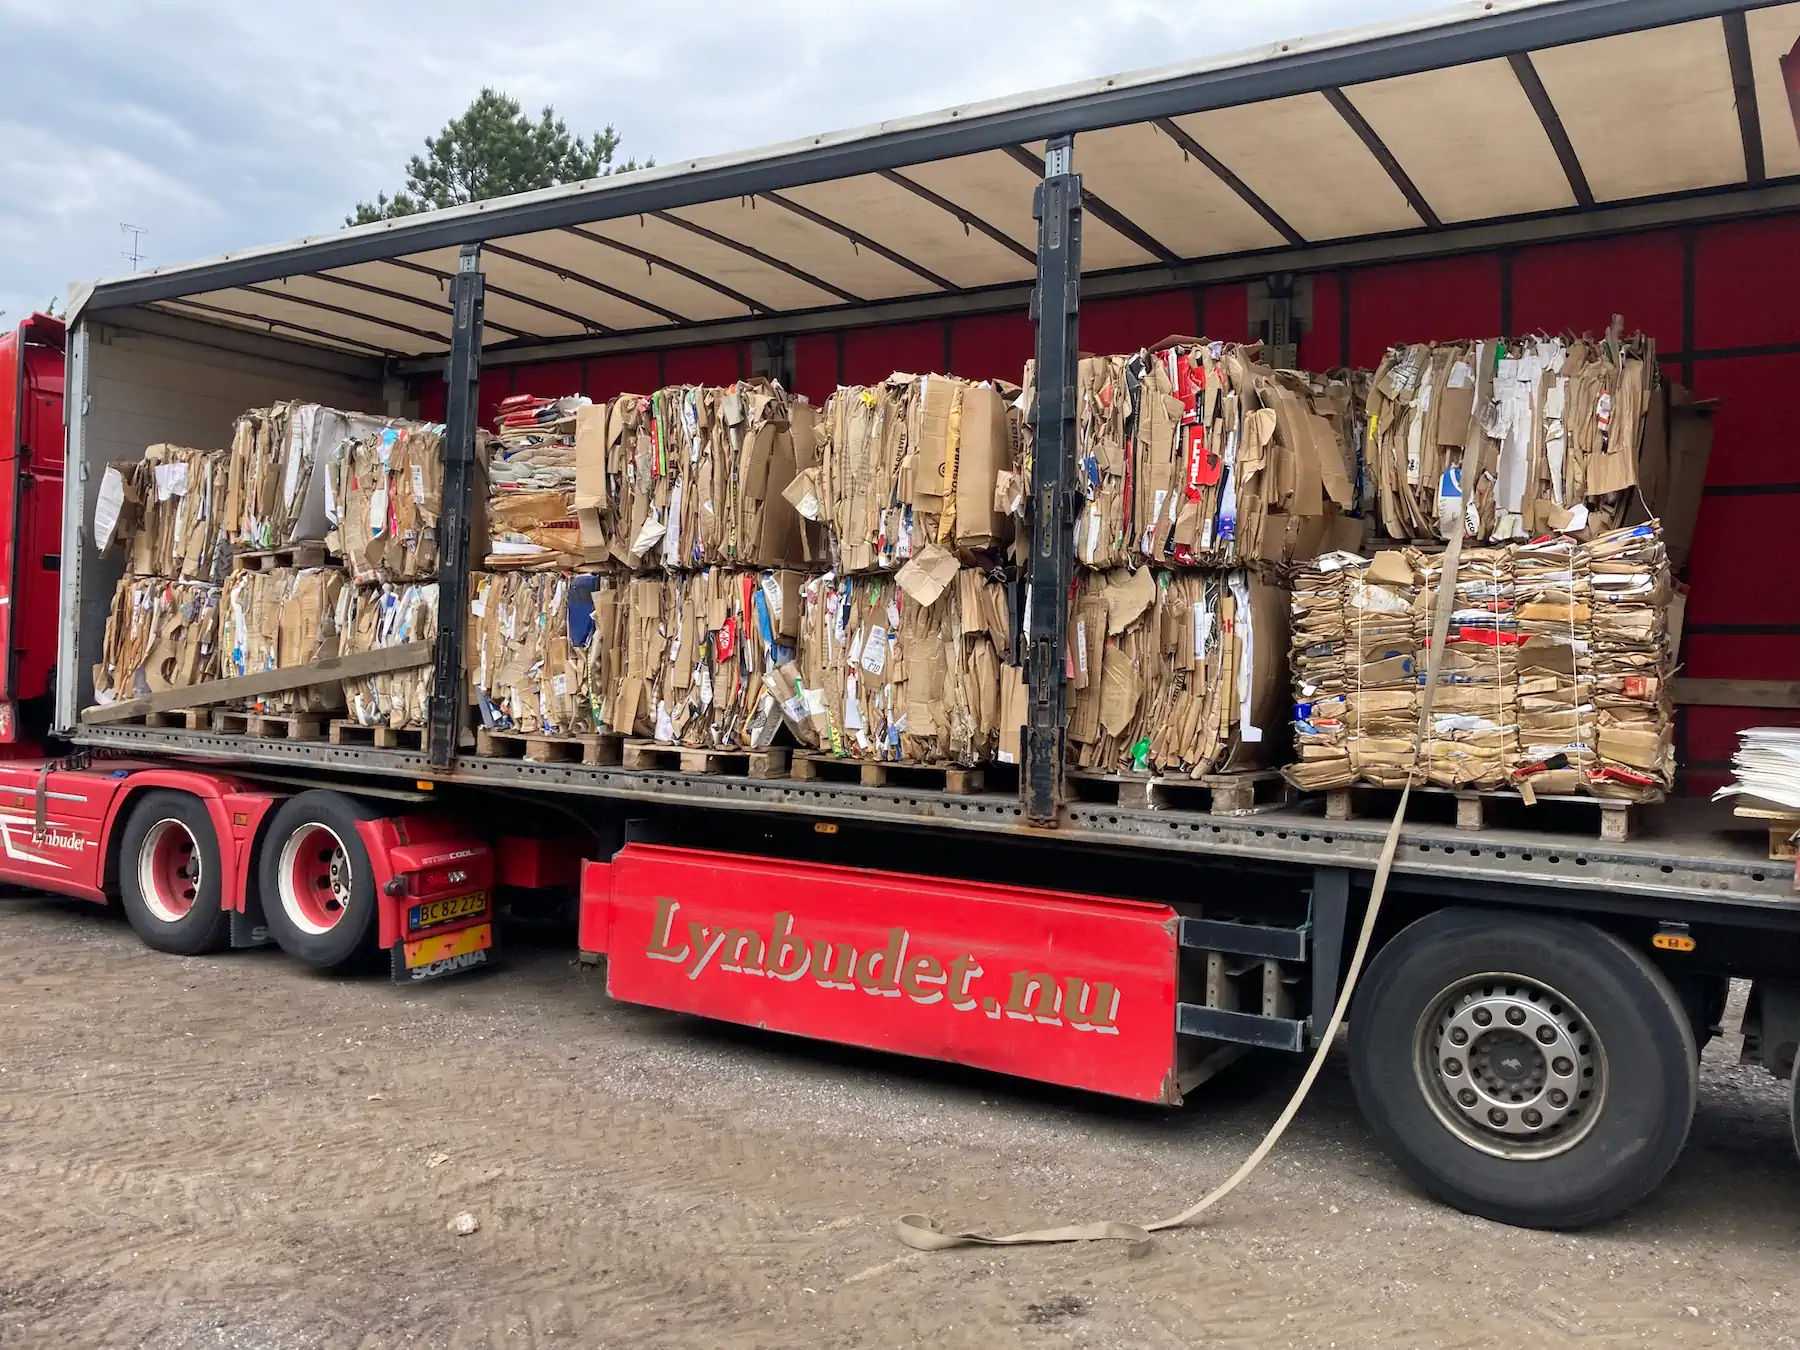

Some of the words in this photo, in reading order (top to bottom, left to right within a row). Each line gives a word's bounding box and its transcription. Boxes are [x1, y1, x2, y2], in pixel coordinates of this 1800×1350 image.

[950, 447, 960, 494] TOSHIBA
[1190, 438, 1202, 486] HILTI
[1464, 512, 1476, 533] HCO
[31, 827, 85, 851] Lynbudet
[421, 904, 439, 921] BC
[441, 900, 457, 916] 82
[460, 893, 485, 912] 275
[411, 949, 487, 980] SCANIA
[646, 895, 1120, 1035] Lynbudet.nu
